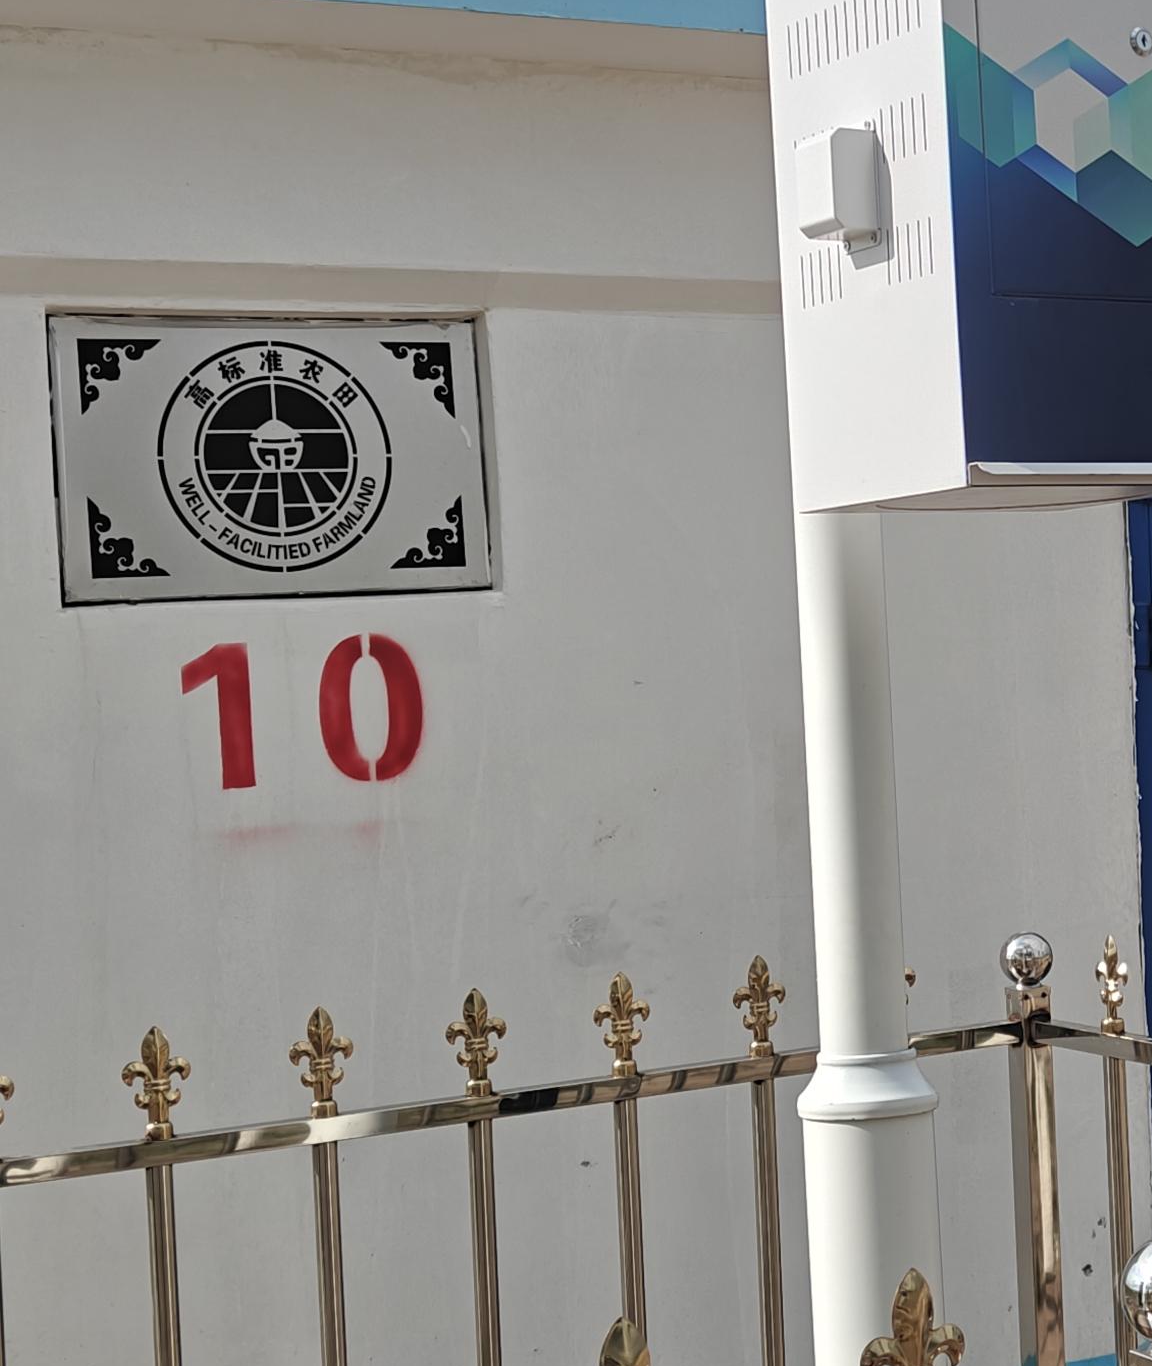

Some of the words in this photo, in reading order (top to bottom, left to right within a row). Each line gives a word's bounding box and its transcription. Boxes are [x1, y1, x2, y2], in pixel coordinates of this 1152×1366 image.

[184, 349, 359, 410] 高标准农田
[311, 476, 377, 553] FARMLAND
[181, 634, 423, 789] 10
